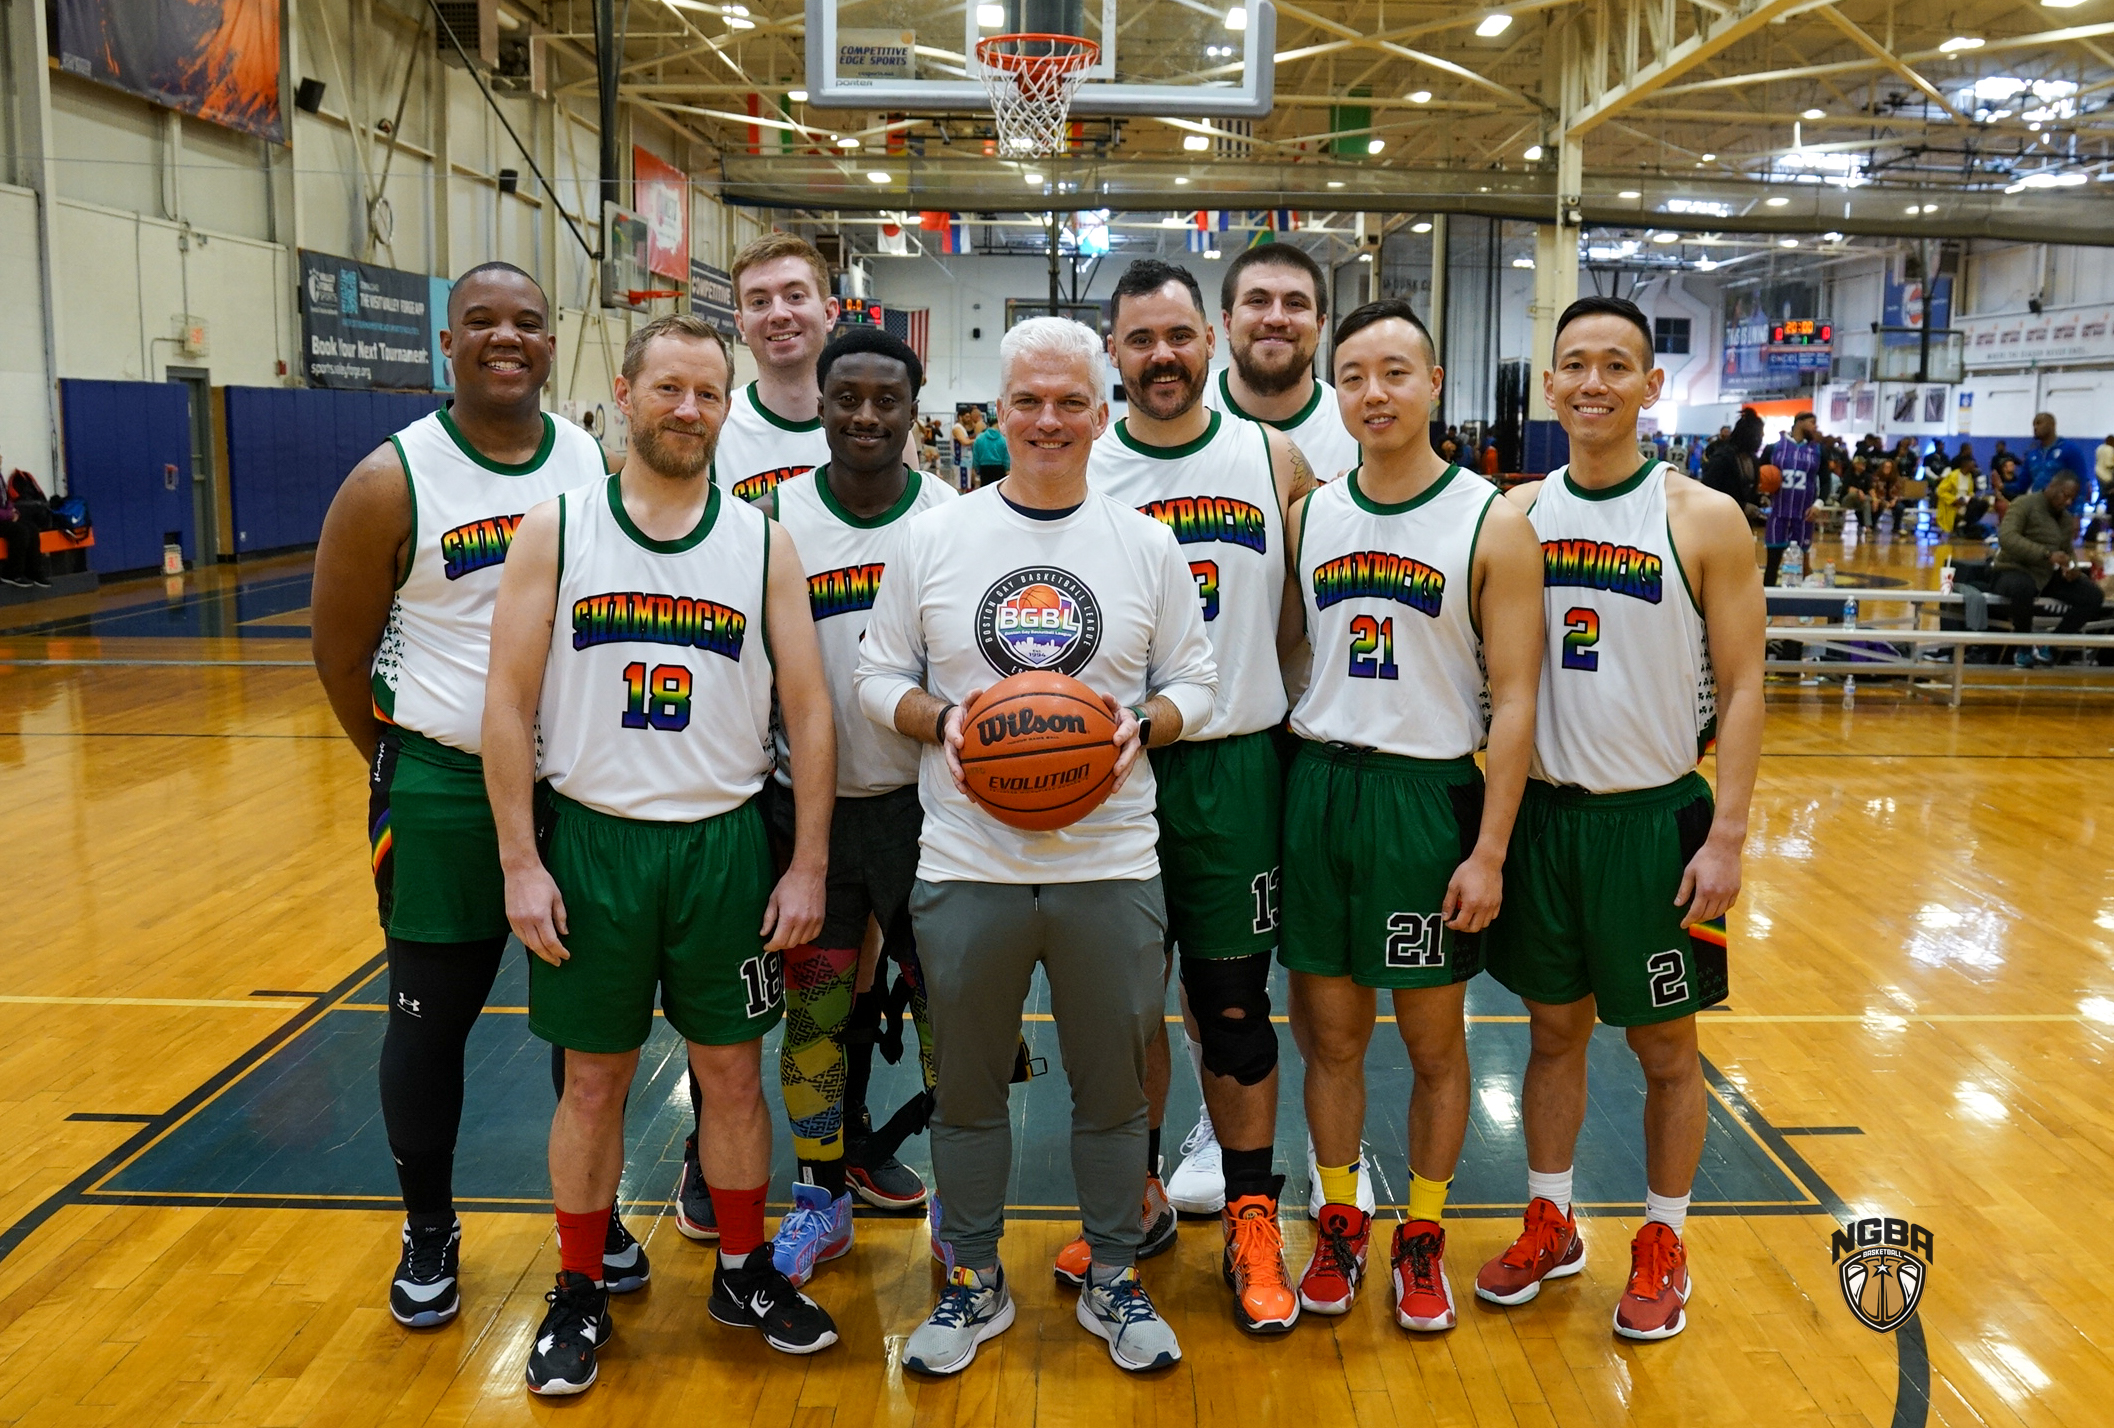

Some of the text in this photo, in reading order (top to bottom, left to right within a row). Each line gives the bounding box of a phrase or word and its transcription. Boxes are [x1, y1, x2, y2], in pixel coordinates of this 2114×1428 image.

[839, 56, 907, 66] EDGE SPORTS
[840, 46, 909, 56] COMPETITIVE
[311, 334, 338, 356] Book
[338, 337, 356, 358] Your
[357, 340, 378, 360] Next
[1785, 320, 1814, 335] 20:00
[1782, 469, 1807, 490] 32
[982, 573, 1095, 647] BOSTON GAY BASKETBALL LEAGUE
[1313, 550, 1446, 619] SHAMROCKS
[572, 591, 746, 663] SHAMROCKS
[1000, 607, 1079, 631] BGBL
[1561, 606, 1600, 672] 2
[1348, 614, 1399, 680] 21
[621, 661, 693, 732] 18
[977, 707, 1087, 746] Wilson
[988, 763, 1090, 790] EVOLUTION
[1386, 912, 1445, 967] 21
[740, 950, 783, 1019] 18
[1646, 948, 1690, 1008] 2
